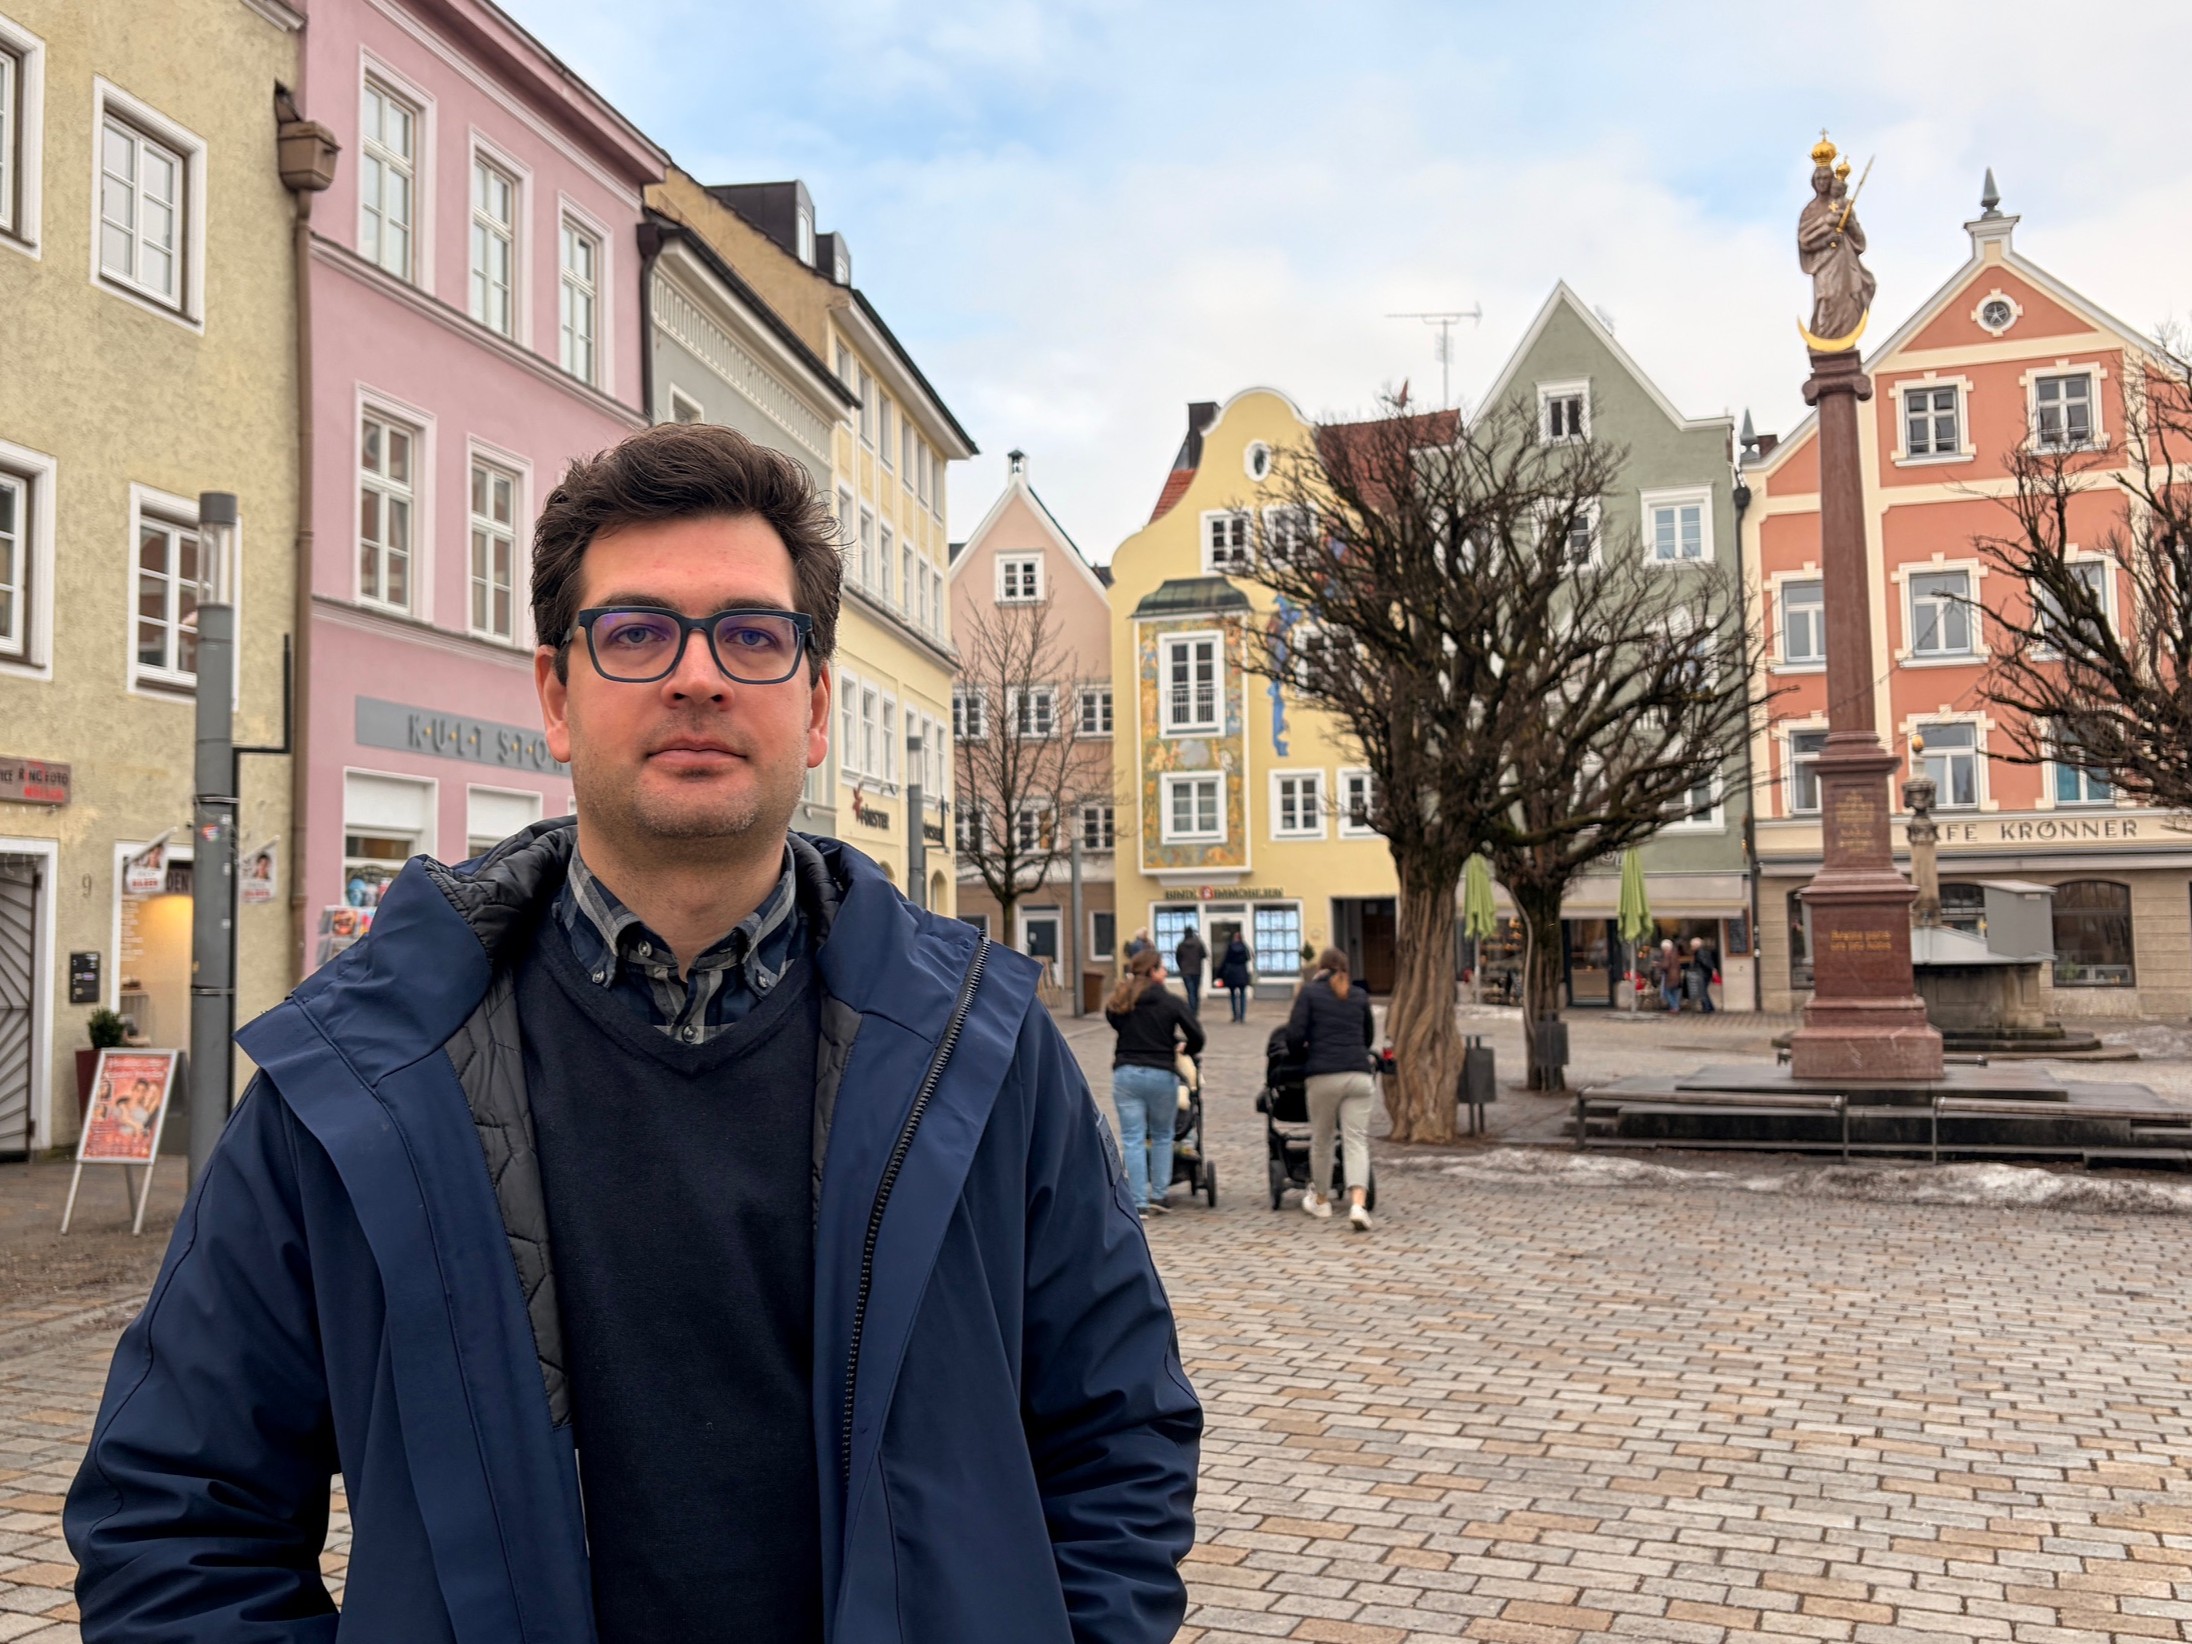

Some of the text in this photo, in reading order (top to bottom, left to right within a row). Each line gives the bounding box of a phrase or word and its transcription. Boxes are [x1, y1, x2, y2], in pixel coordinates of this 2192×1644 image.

[408, 713, 564, 772] KULT STO
[82, 873, 92, 898] 9
